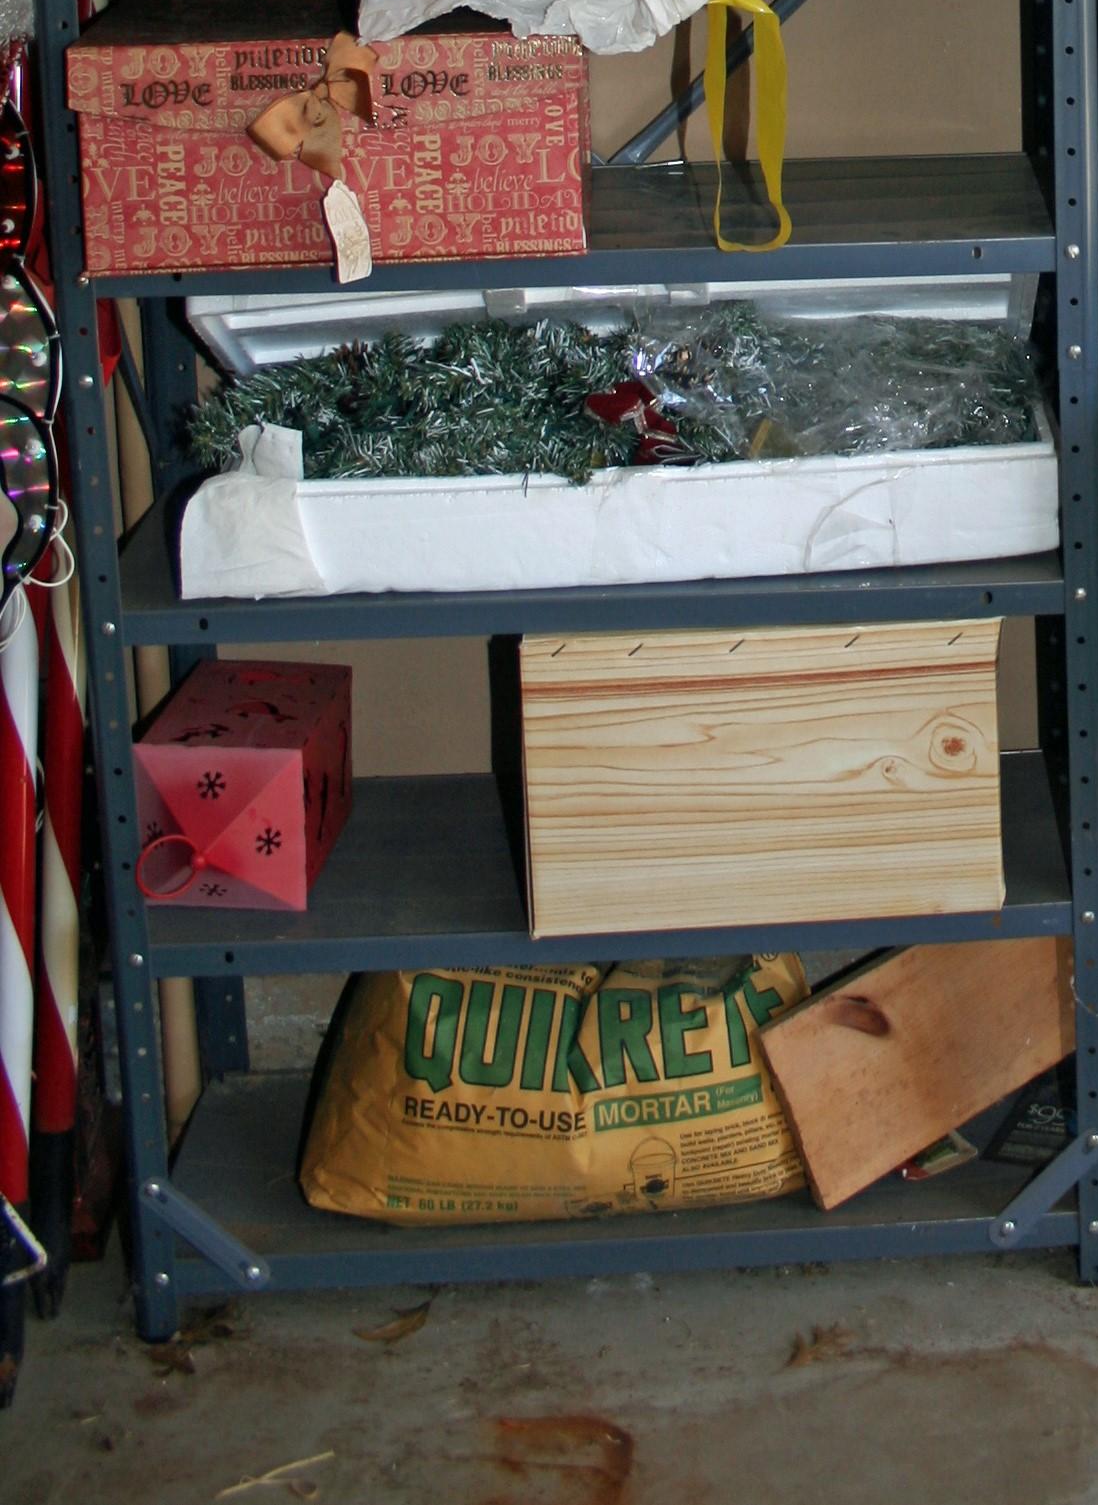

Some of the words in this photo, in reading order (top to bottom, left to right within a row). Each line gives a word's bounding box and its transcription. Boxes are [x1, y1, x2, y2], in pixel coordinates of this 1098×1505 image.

[120, 46, 215, 80] JOY
[214, 47, 229, 106] believe
[119, 79, 214, 109] LOVE
[230, 72, 308, 92] BLESSINGS
[380, 70, 470, 99] LOVE
[506, 117, 540, 127] merry
[450, 133, 542, 166] JOY
[156, 144, 189, 225] PEACE
[413, 133, 445, 213] PEACE
[473, 167, 534, 194] believe
[217, 177, 279, 205] believe
[131, 223, 227, 258] JOY
[244, 223, 326, 254] yuletid
[390, 212, 482, 247] JOY
[500, 210, 580, 243] yuletid
[403, 1096, 587, 1133] READY-TO-USE
[599, 1090, 711, 1127] MORTAR
[439, 1199, 456, 1212] LB
